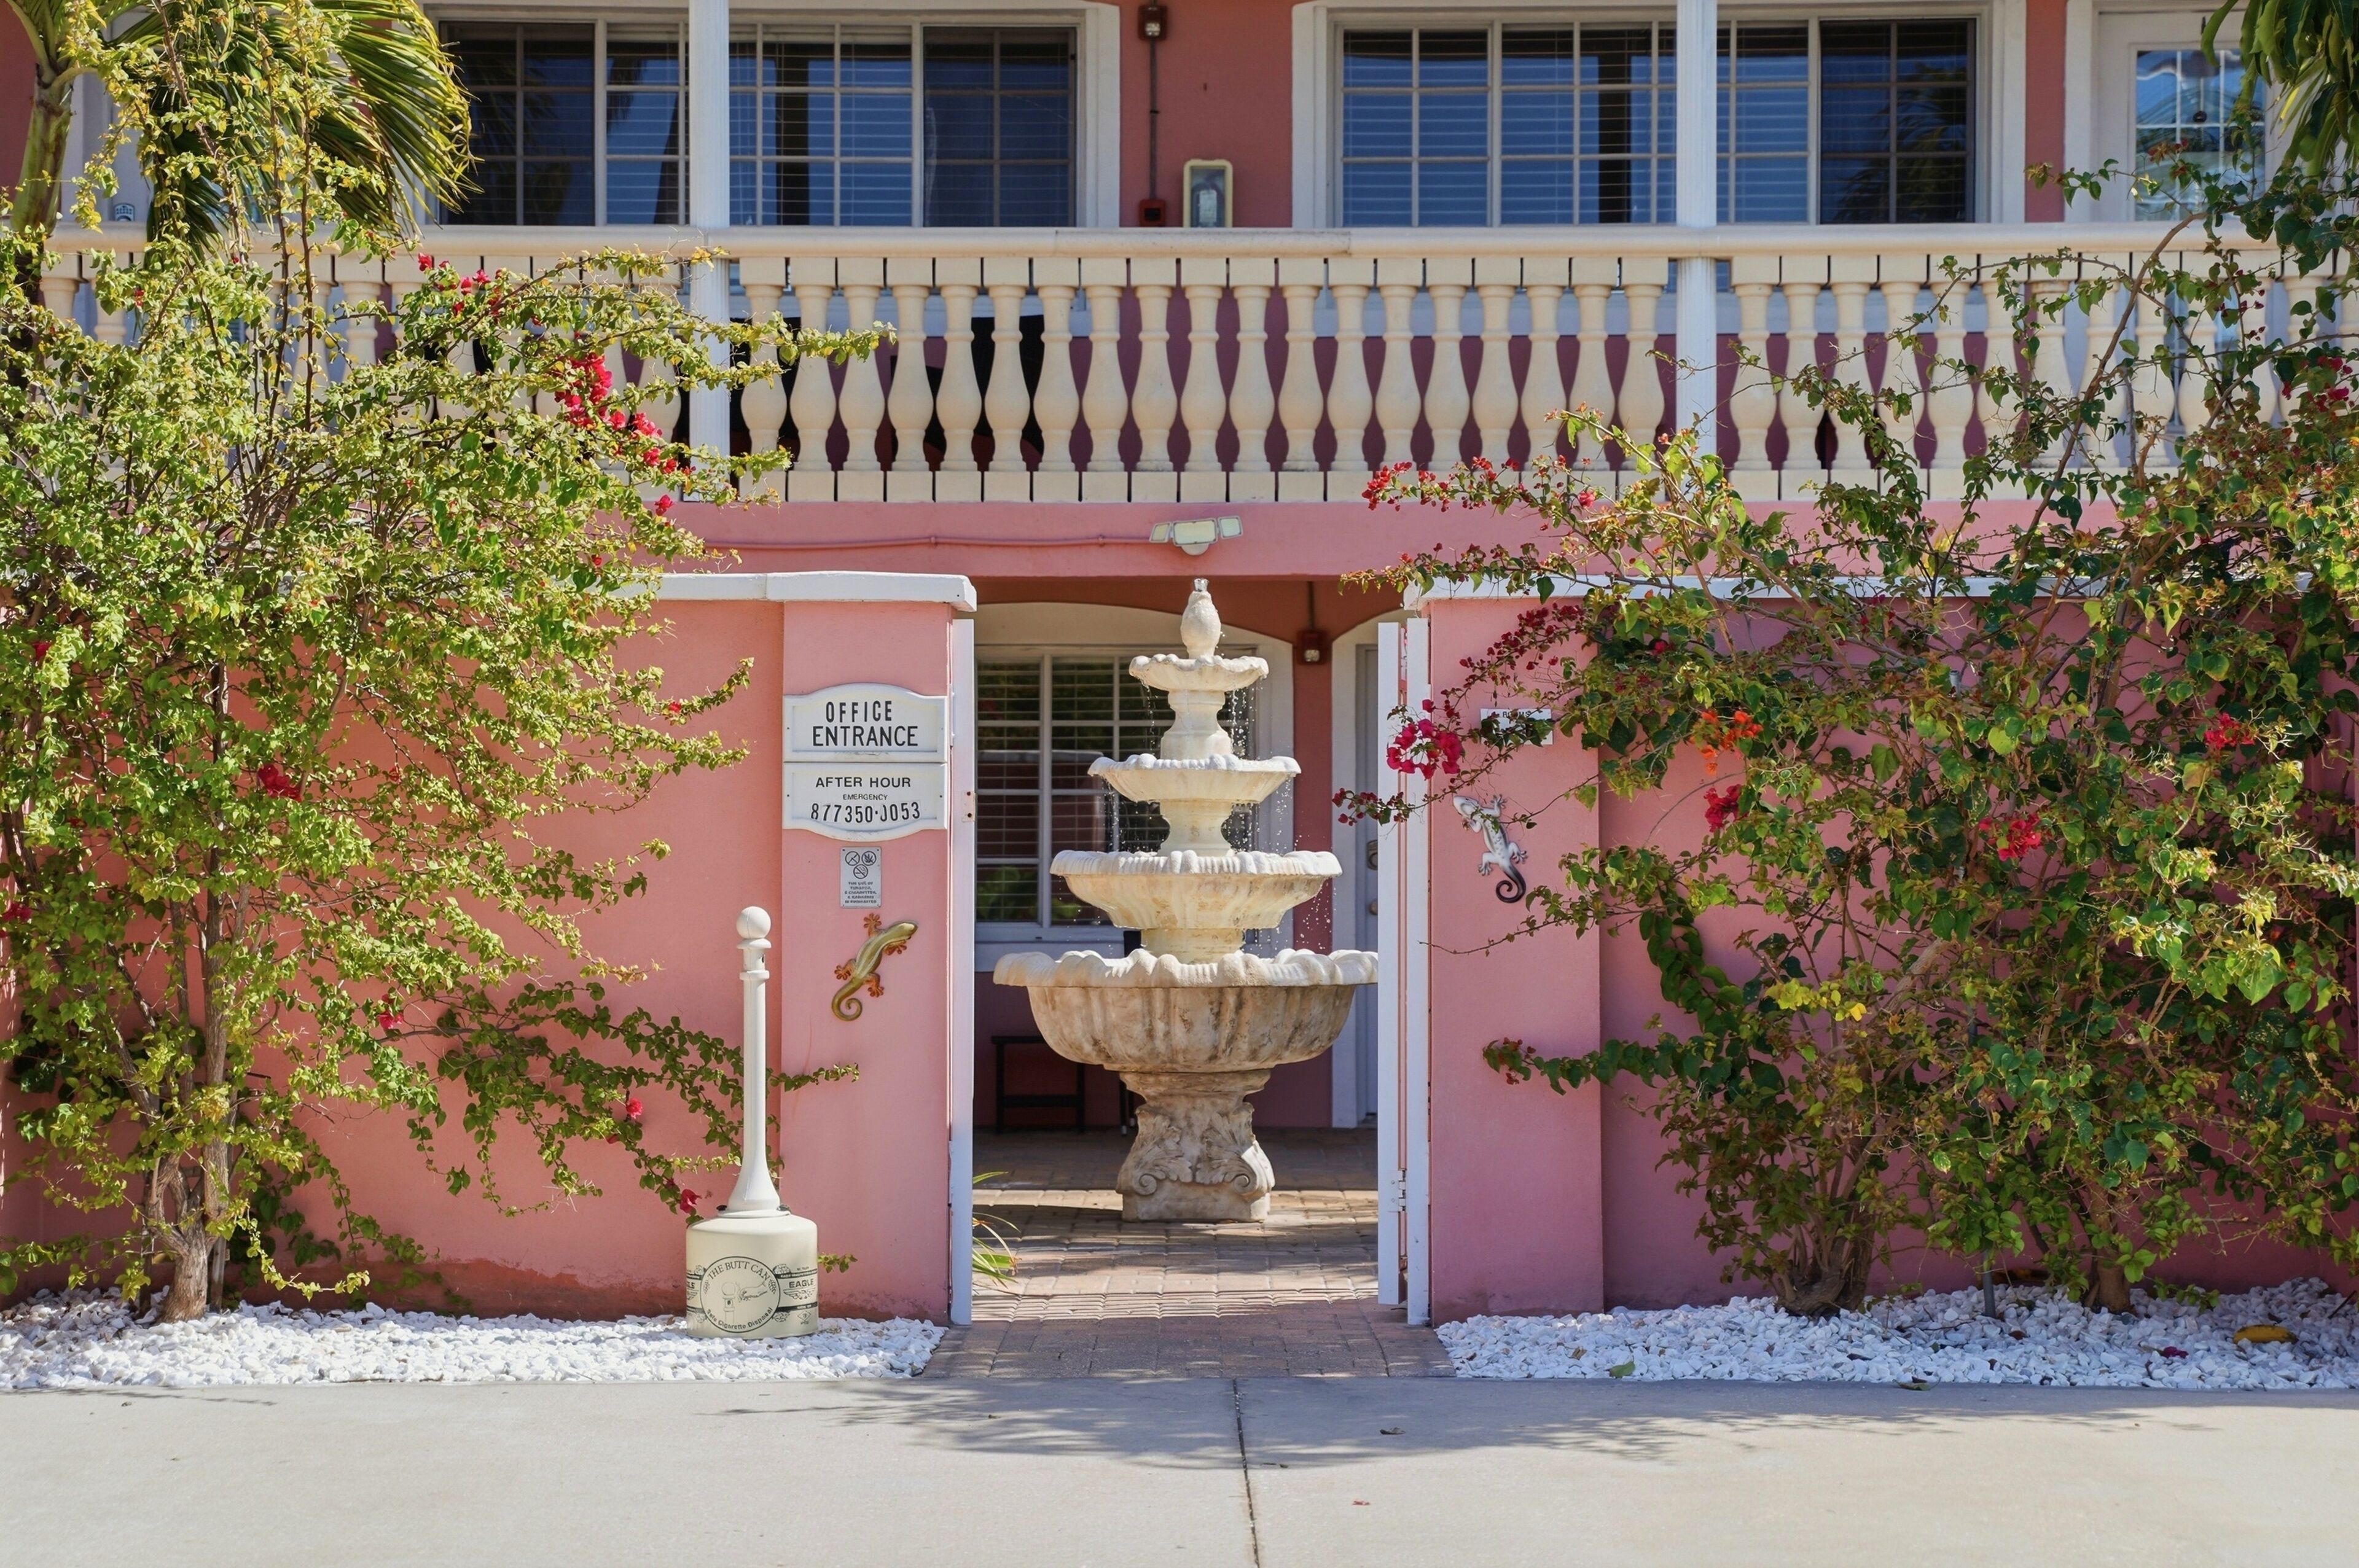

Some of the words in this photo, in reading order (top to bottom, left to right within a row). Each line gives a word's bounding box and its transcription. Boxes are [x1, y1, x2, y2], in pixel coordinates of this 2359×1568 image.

[826, 700, 892, 723] OFFICE
[812, 725, 918, 747] ENTRANCE
[815, 777, 863, 788] AFTER
[869, 777, 911, 787] HOUR
[707, 1264, 724, 1280] THE
[724, 1260, 750, 1271] BUTT
[751, 1264, 770, 1281] CAN
[789, 1278, 814, 1289] EAGLE
